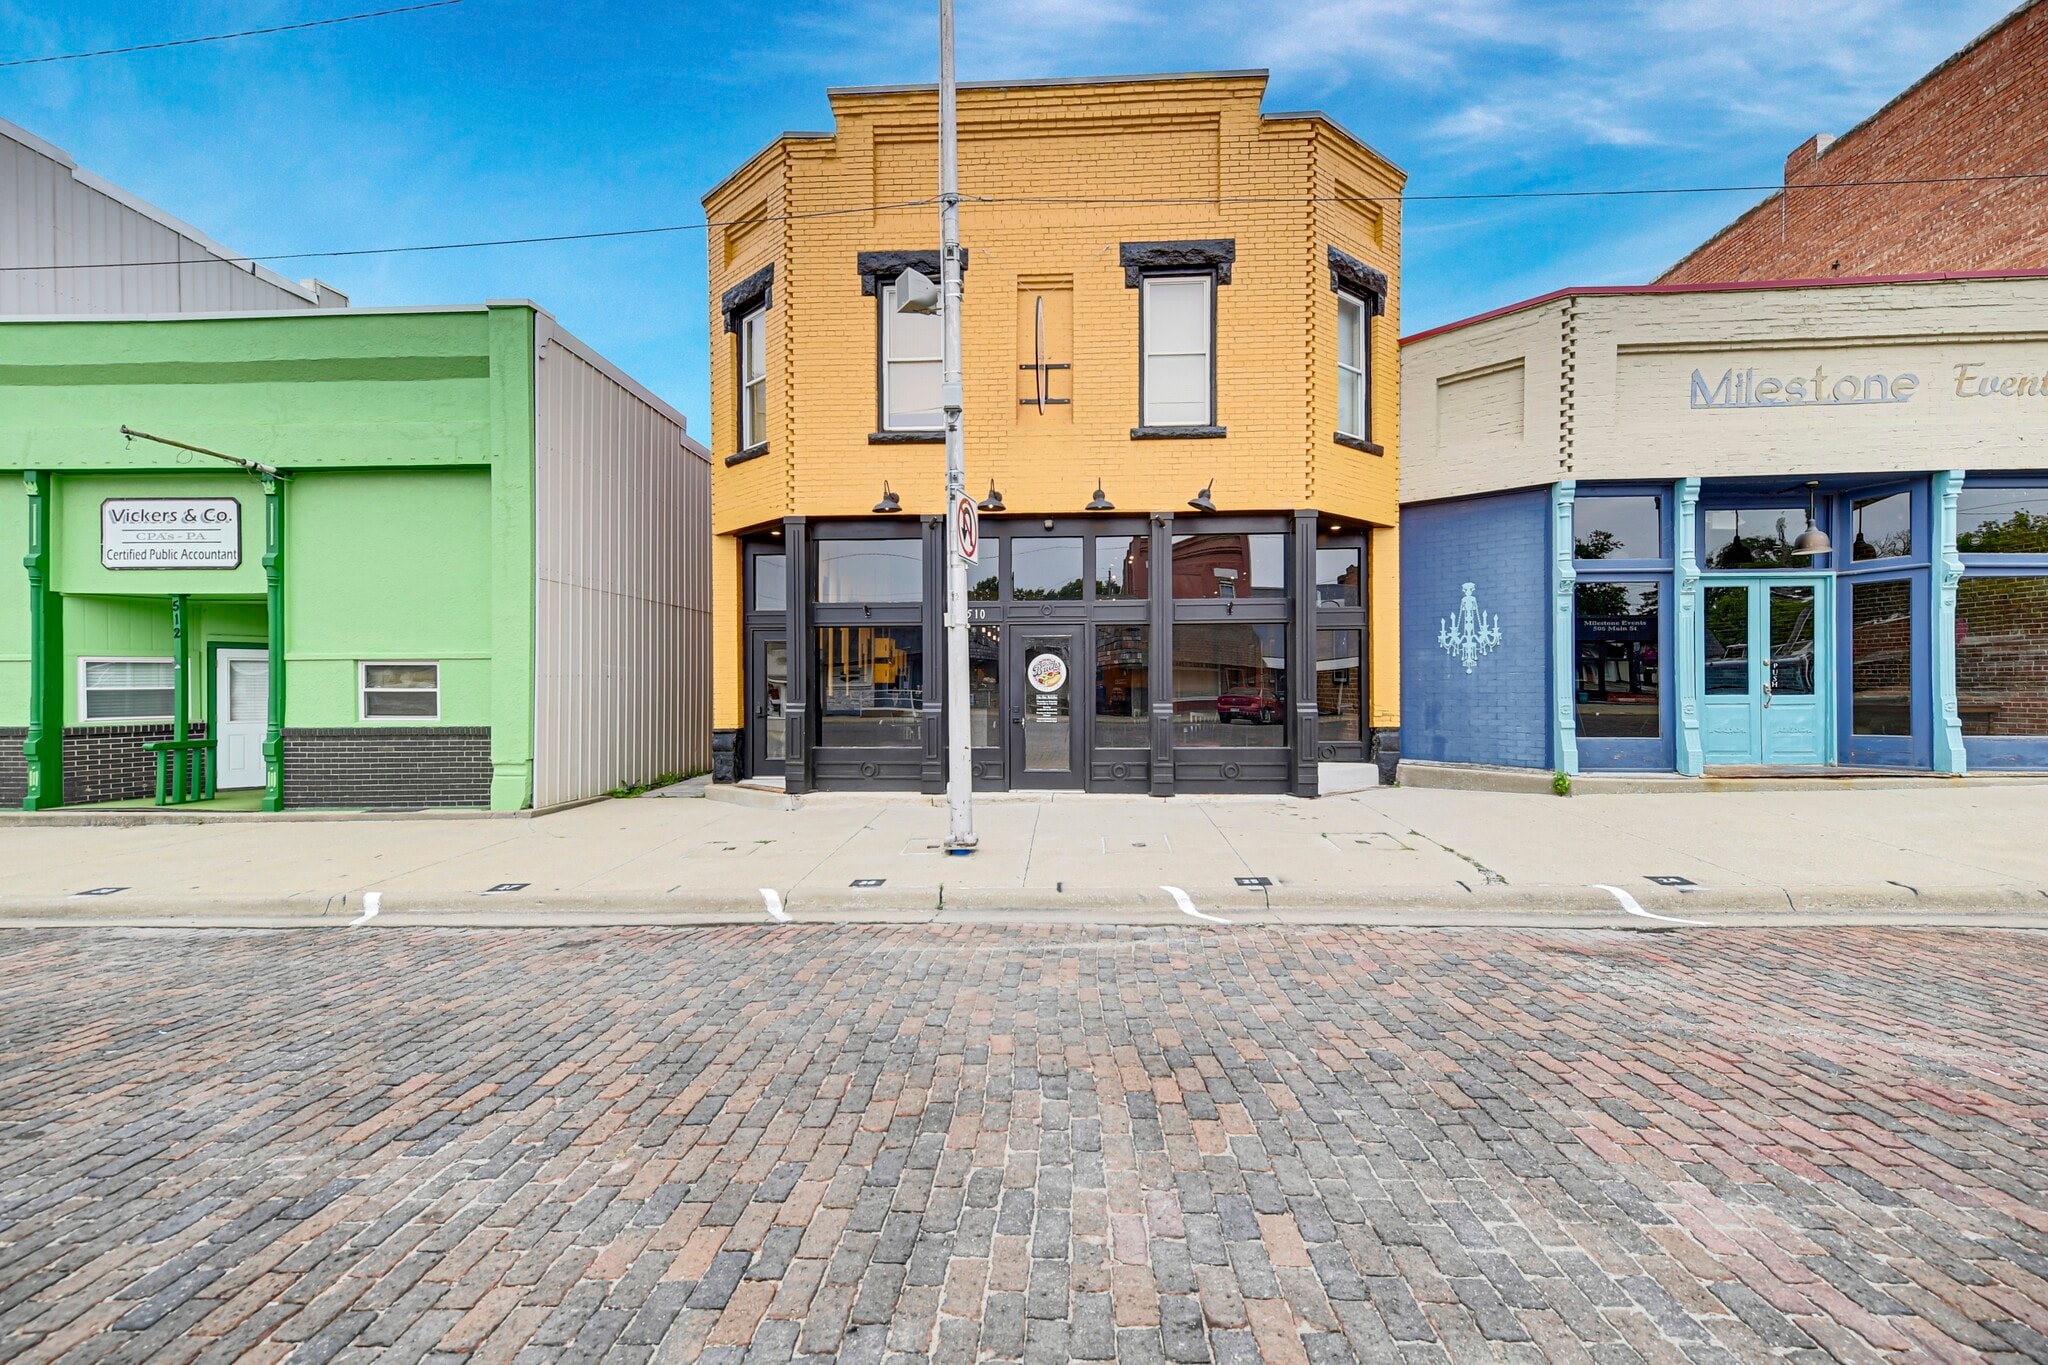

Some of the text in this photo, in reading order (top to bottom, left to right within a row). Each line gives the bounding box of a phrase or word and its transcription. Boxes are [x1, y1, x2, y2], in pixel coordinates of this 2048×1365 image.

[1691, 365, 1920, 409] Milestone
[109, 508, 232, 523] Vickers & Co.
[187, 532, 207, 540] PA
[106, 548, 237, 560] Certified Public Accountant
[172, 600, 181, 639] 512
